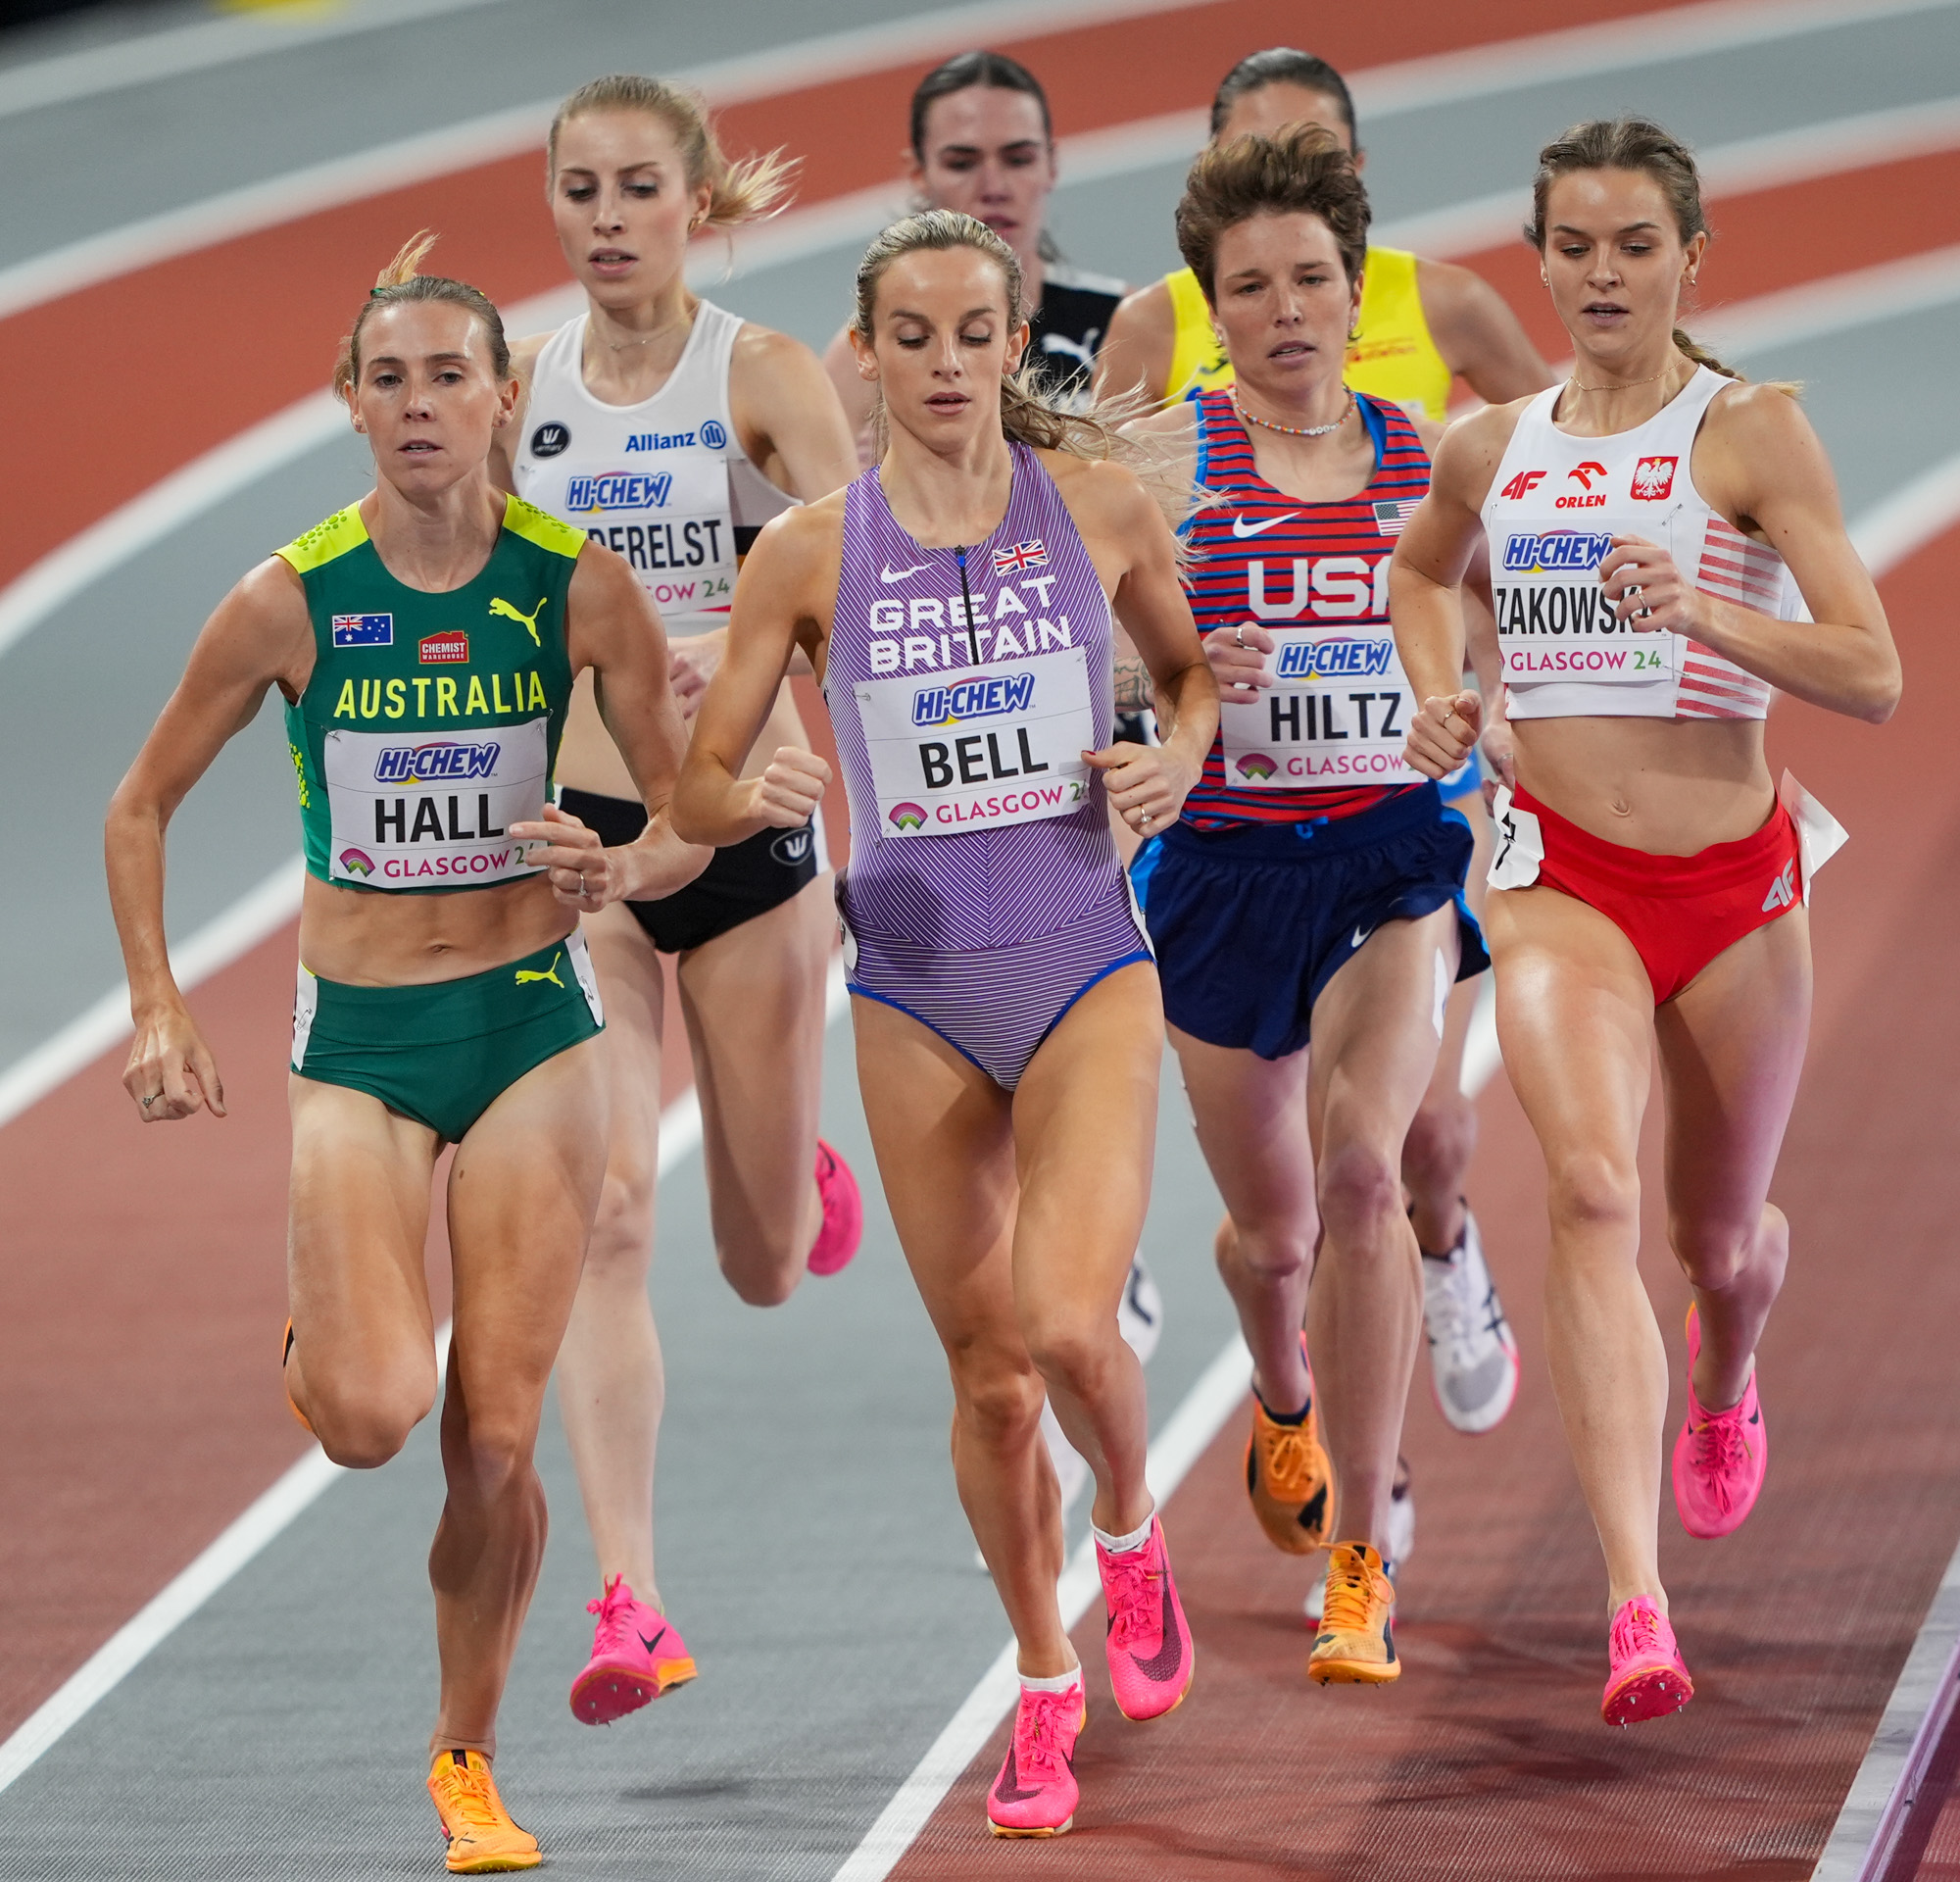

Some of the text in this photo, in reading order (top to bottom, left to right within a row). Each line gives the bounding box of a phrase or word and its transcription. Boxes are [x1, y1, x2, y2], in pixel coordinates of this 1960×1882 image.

[625, 431, 697, 453] Allianz
[565, 471, 672, 511] HI-CHEW
[1554, 494, 1606, 509] ORLEN
[647, 577, 730, 603] OW 24
[870, 574, 1056, 632] GREAT
[1496, 586, 1663, 634] ZAKOWSK
[421, 642, 466, 654] CHEMIST
[869, 616, 1072, 673] BRITAIN
[1276, 639, 1393, 678] HI-CHEW
[1510, 651, 1662, 671] GLASGOW 24
[333, 670, 547, 718] AUSTRALIA
[912, 672, 1035, 726] HI-CHEW
[1270, 692, 1402, 742] HILTZ
[374, 742, 500, 781] HI-CHEW
[918, 727, 1049, 789] BELL
[1287, 753, 1403, 776] GLASGOW
[374, 794, 505, 843] HALL
[936, 785, 1063, 824] GLASGOW
[383, 850, 511, 878] GLASGOW
